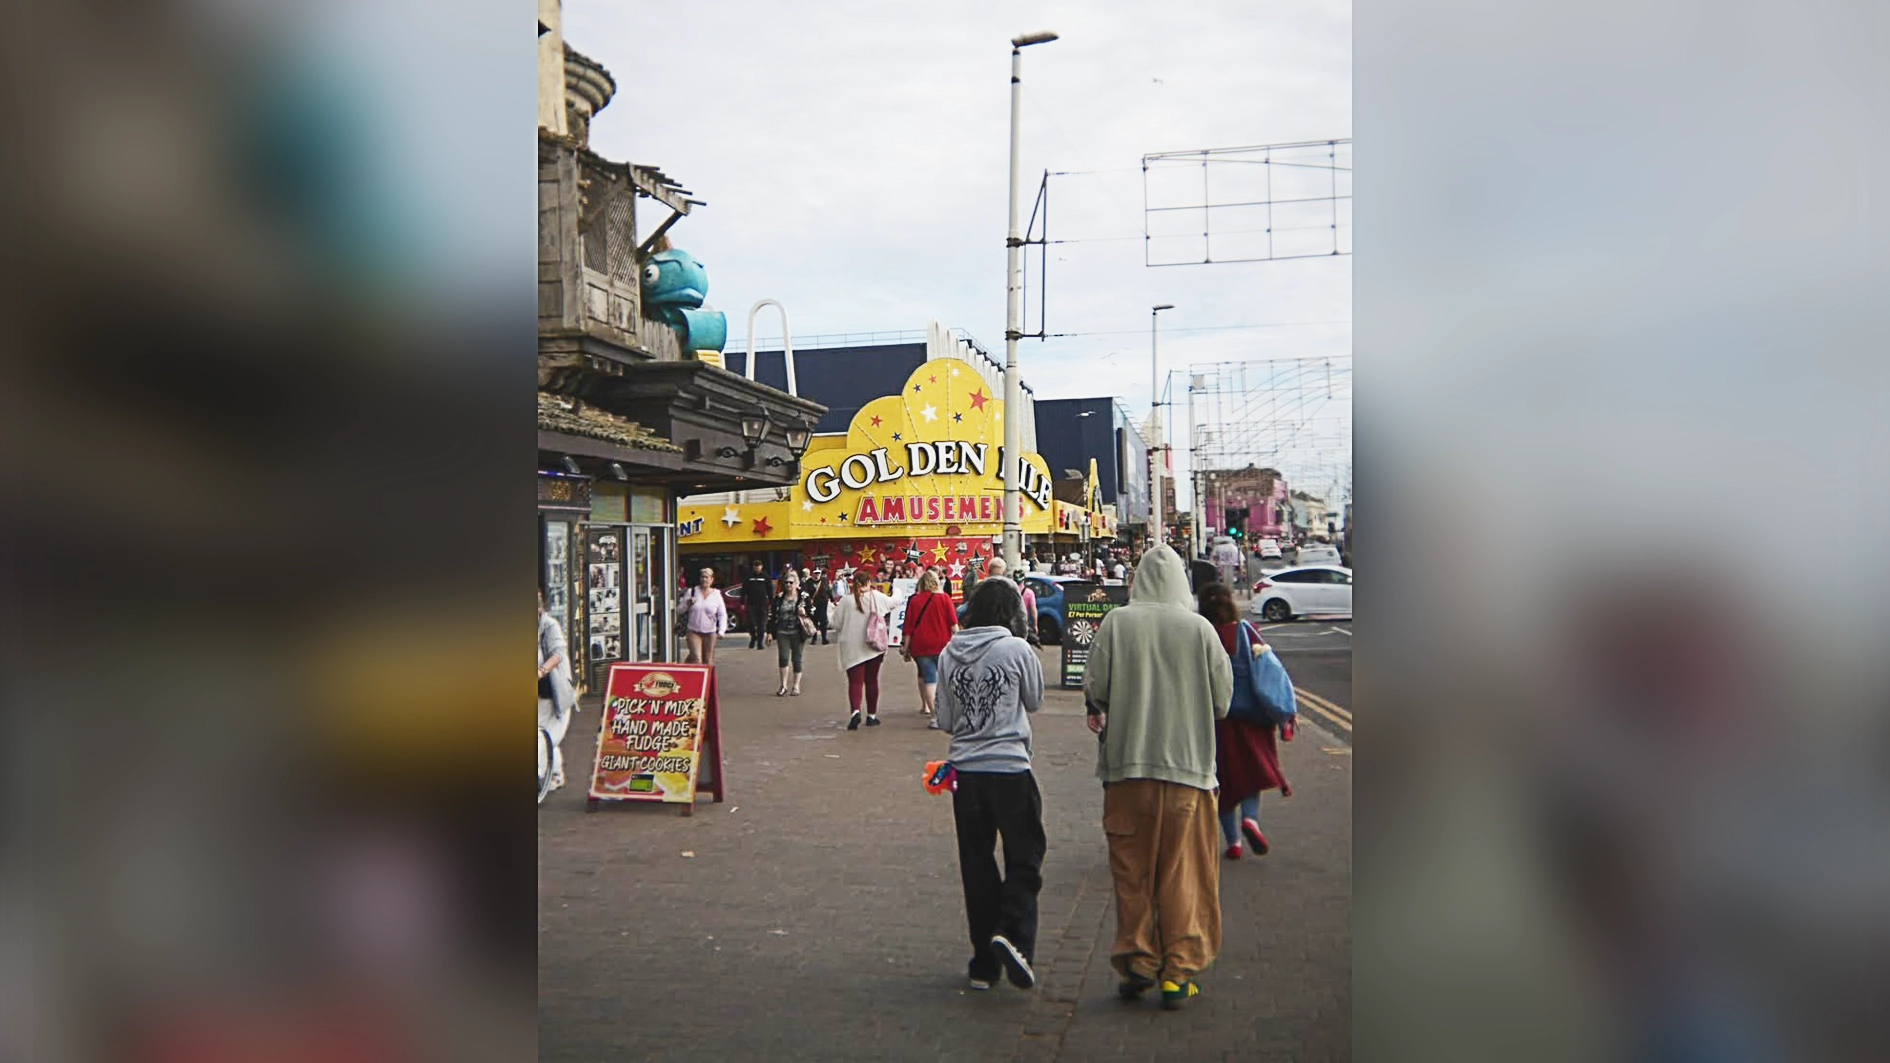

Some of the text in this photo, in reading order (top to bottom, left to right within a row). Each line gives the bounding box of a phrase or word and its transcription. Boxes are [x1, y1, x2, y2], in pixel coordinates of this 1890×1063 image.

[805, 441, 988, 503] GOLDEN
[1068, 603, 1101, 612] VIRTUAL
[615, 697, 647, 716] PICK
[664, 699, 692, 717] MIX
[612, 719, 691, 737] HAND MADE
[626, 735, 671, 752] FUDGE
[601, 755, 692, 773] GIANT COOKIES
